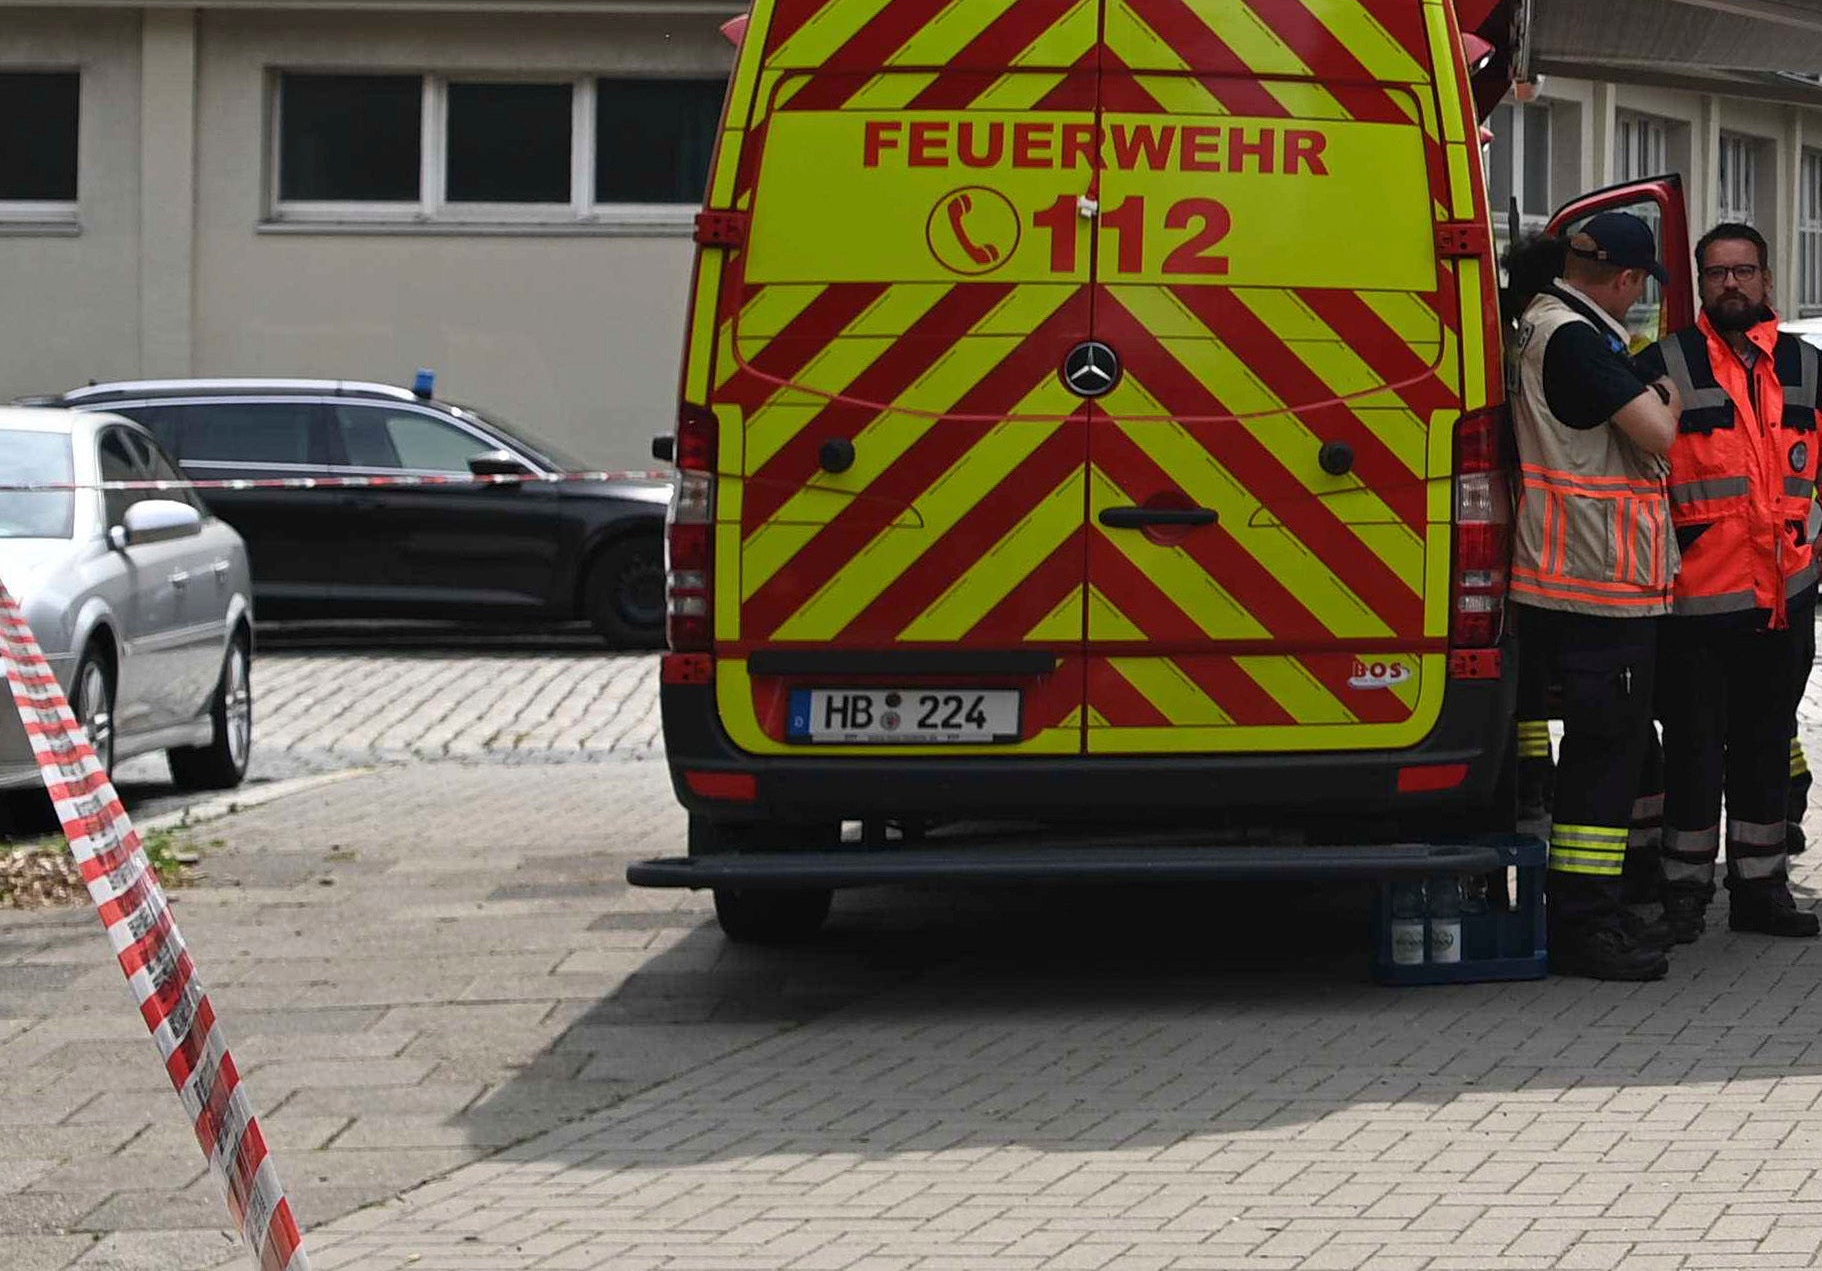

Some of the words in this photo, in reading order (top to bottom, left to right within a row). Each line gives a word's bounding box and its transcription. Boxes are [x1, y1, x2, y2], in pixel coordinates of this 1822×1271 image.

[863, 121, 1329, 176] FEUERWEHR
[1032, 193, 1232, 276] 112
[1352, 660, 1402, 679] BOS
[824, 694, 874, 730] HB
[916, 694, 987, 730] 224
